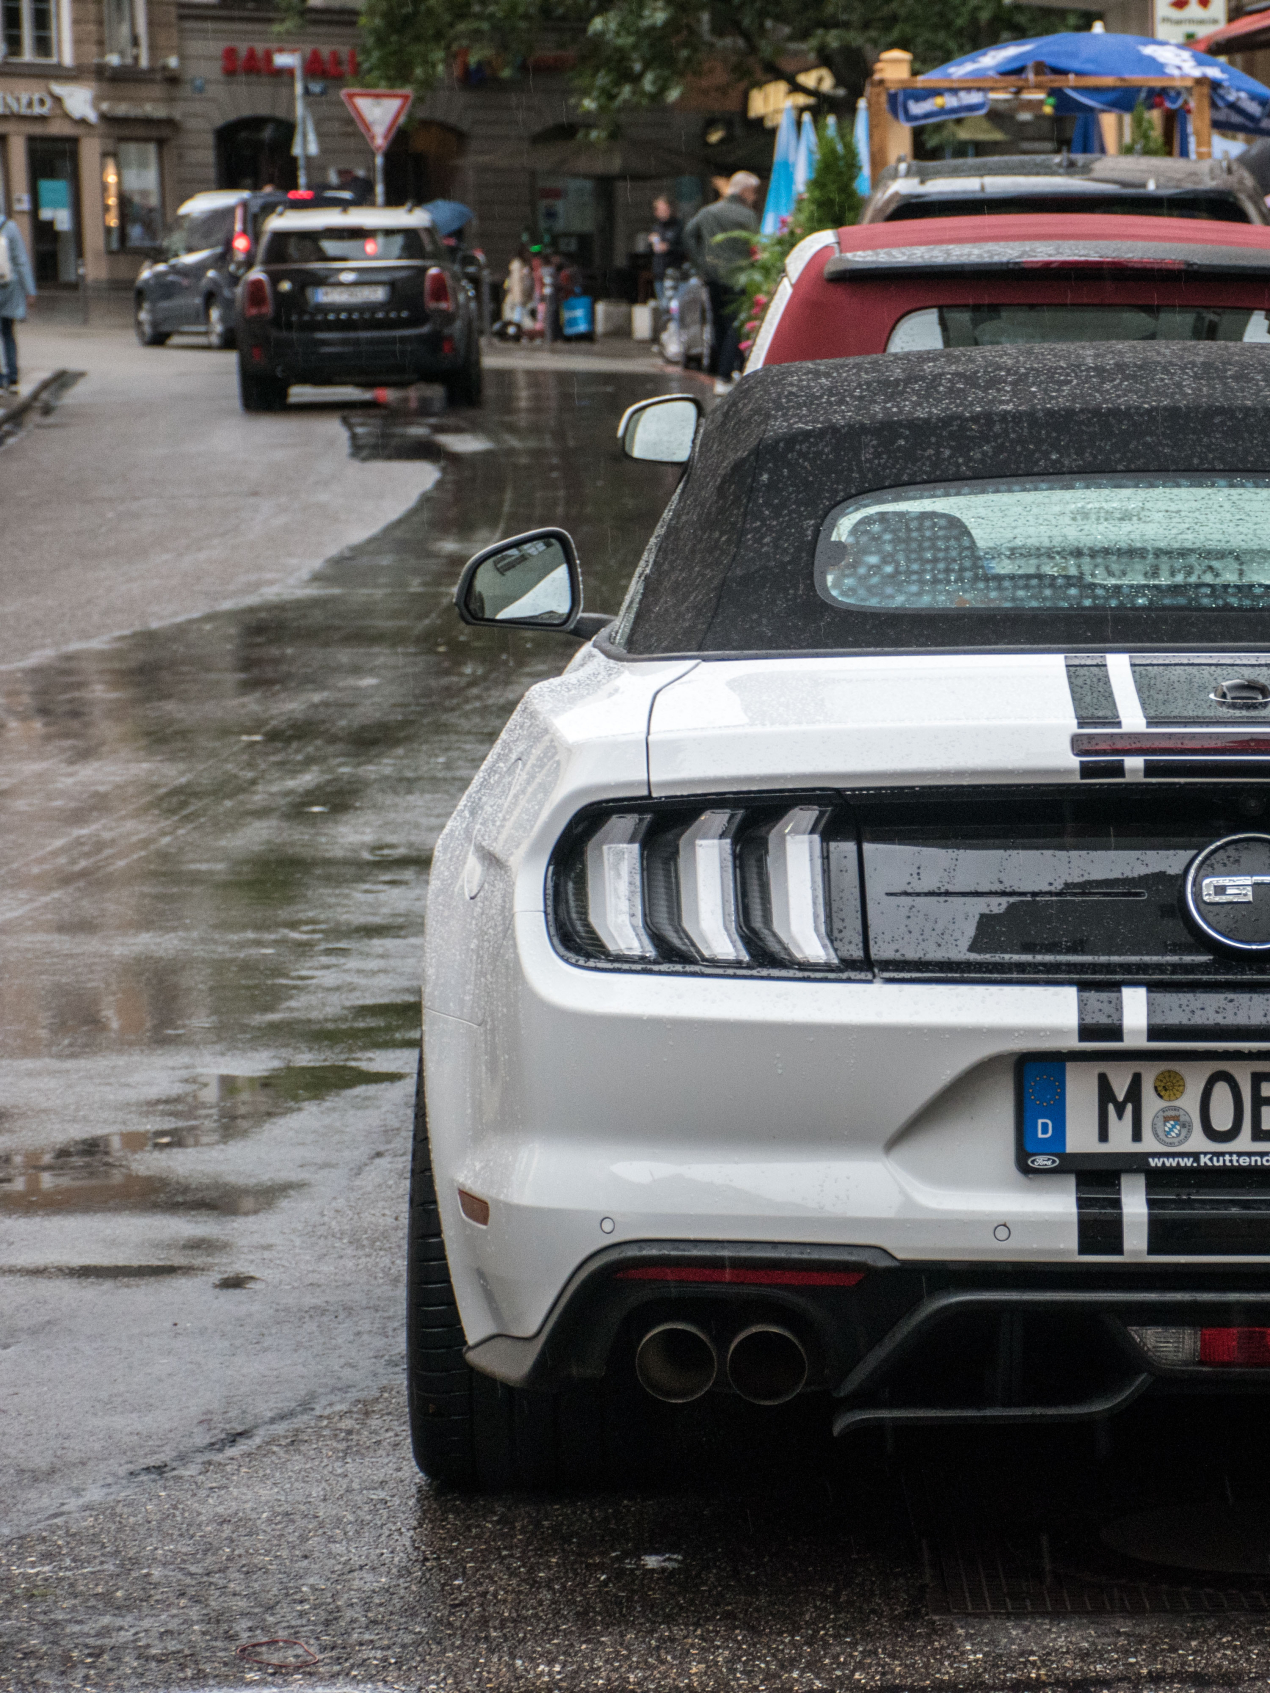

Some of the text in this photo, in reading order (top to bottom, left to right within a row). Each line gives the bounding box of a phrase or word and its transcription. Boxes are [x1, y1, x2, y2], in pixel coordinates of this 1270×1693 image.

[1098, 1071, 1143, 1143] M
[1037, 1118, 1053, 1139] D
[1031, 1156, 1056, 1167] Ford
